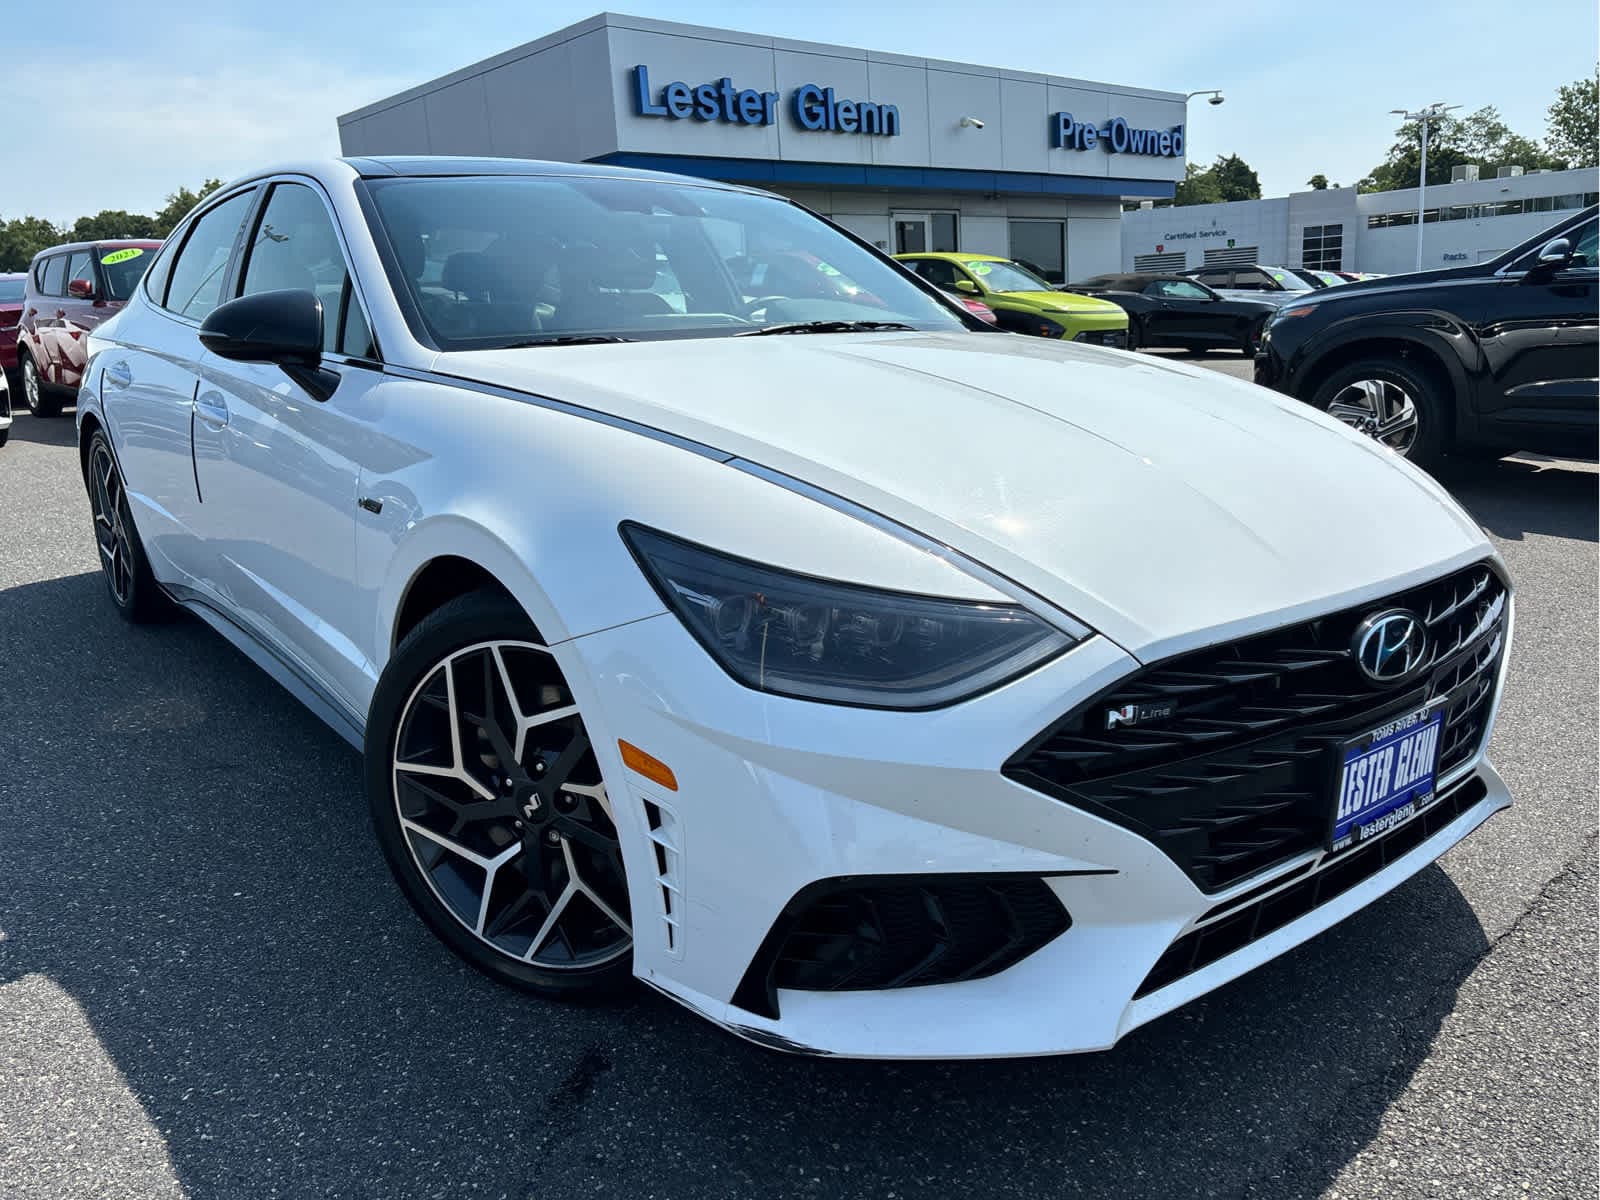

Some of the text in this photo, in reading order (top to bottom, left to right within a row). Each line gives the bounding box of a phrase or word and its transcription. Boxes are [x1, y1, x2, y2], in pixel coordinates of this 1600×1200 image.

[633, 65, 900, 136] Lester Glenn
[1054, 112, 1184, 157] Pre-Owned
[1164, 229, 1227, 241] Certified Service
[1371, 724, 1394, 743] TOMS
[1419, 708, 1430, 722] NJ
[1337, 723, 1440, 820] LESTER GLENN
[1360, 802, 1415, 840] lesterglenn
